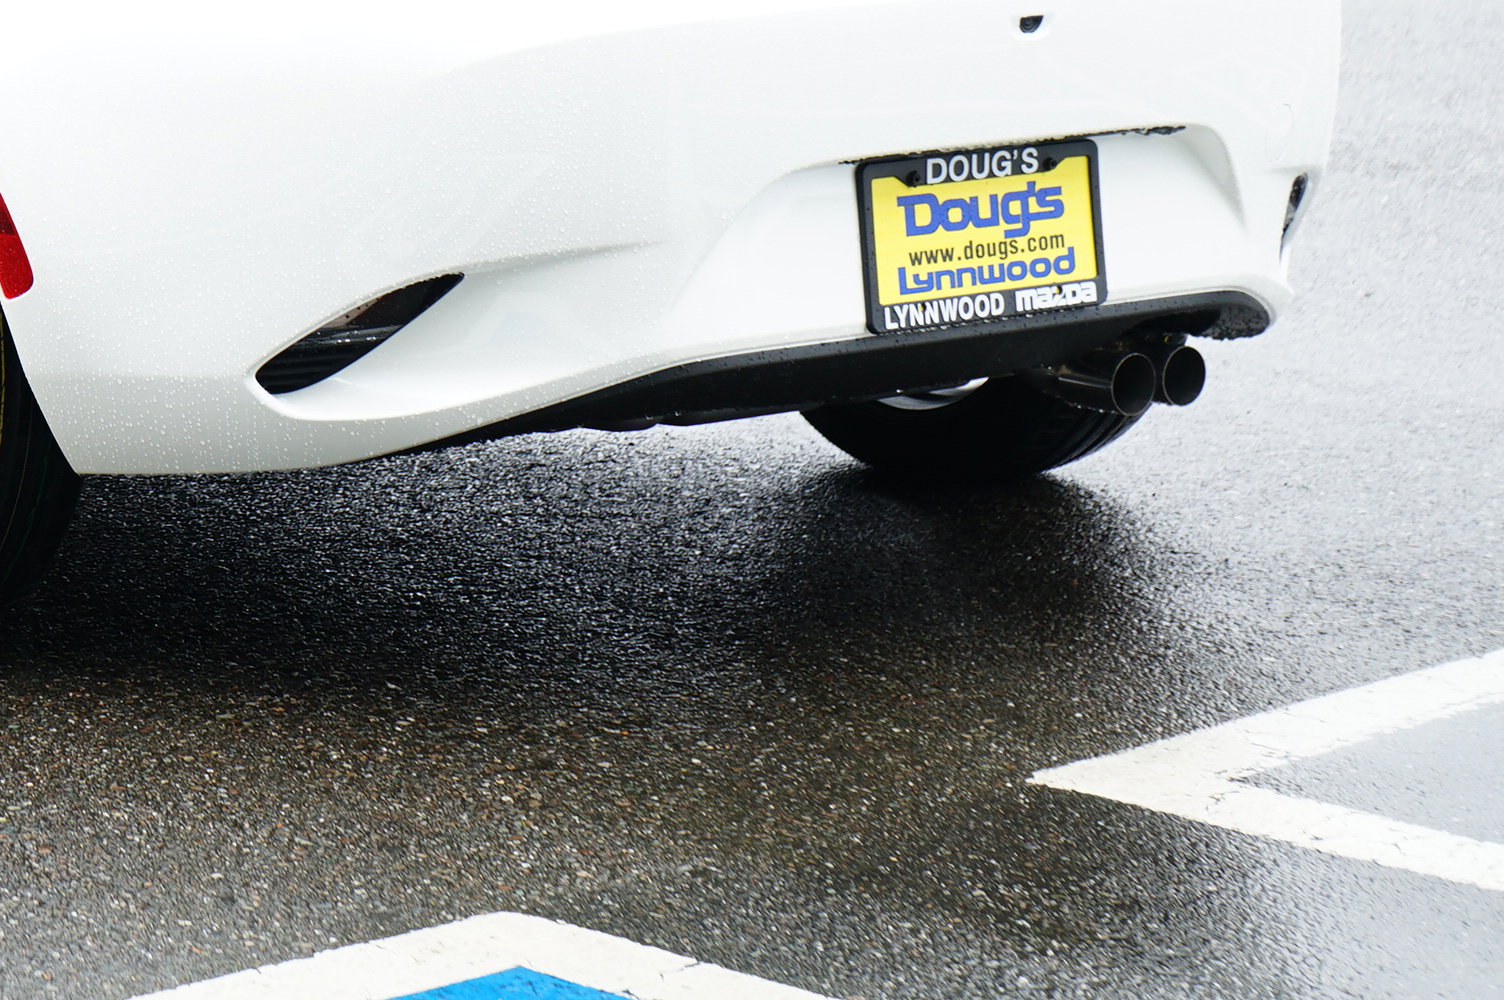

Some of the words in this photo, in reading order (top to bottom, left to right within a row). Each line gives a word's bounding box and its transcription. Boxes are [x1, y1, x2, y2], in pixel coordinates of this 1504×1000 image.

[925, 146, 1039, 185] DOUG'S
[897, 181, 1065, 239] Doug's
[908, 234, 1066, 266] www.dougs.com
[898, 246, 1076, 295] Lynnwood
[883, 292, 1006, 331] LYNNWOOD
